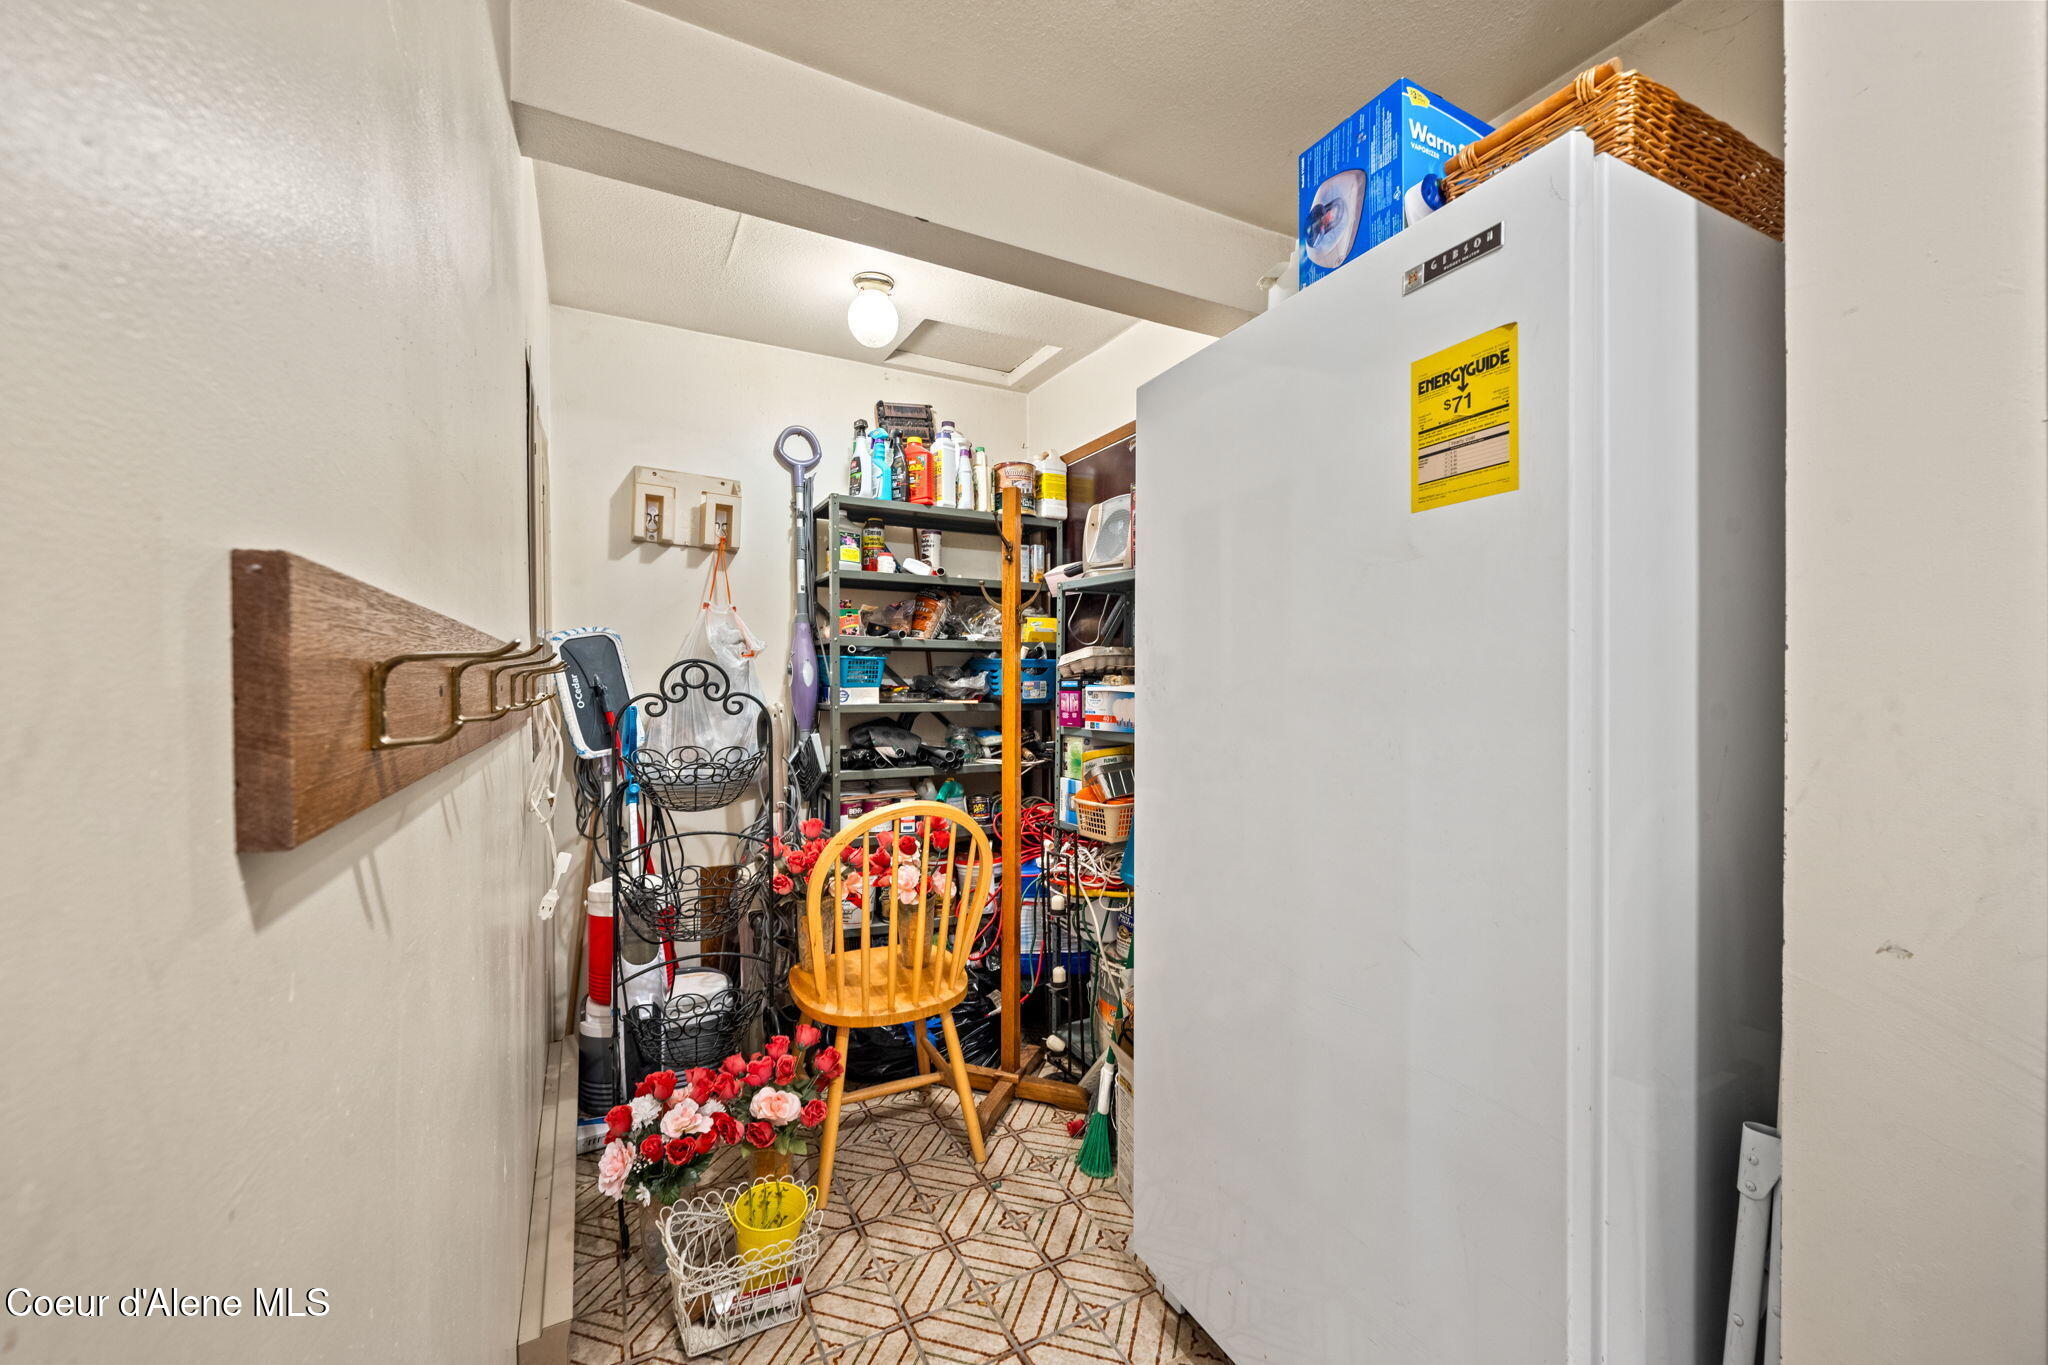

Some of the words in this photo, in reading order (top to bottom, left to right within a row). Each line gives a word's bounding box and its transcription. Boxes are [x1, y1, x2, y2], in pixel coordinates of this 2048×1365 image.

[1408, 117, 1457, 156] Warm
[1430, 230, 1494, 270] GIBSON
[1418, 349, 1510, 396] ENERGYGUIDE
[1443, 391, 1472, 414] $71
[571, 674, 585, 709] O-Cedar
